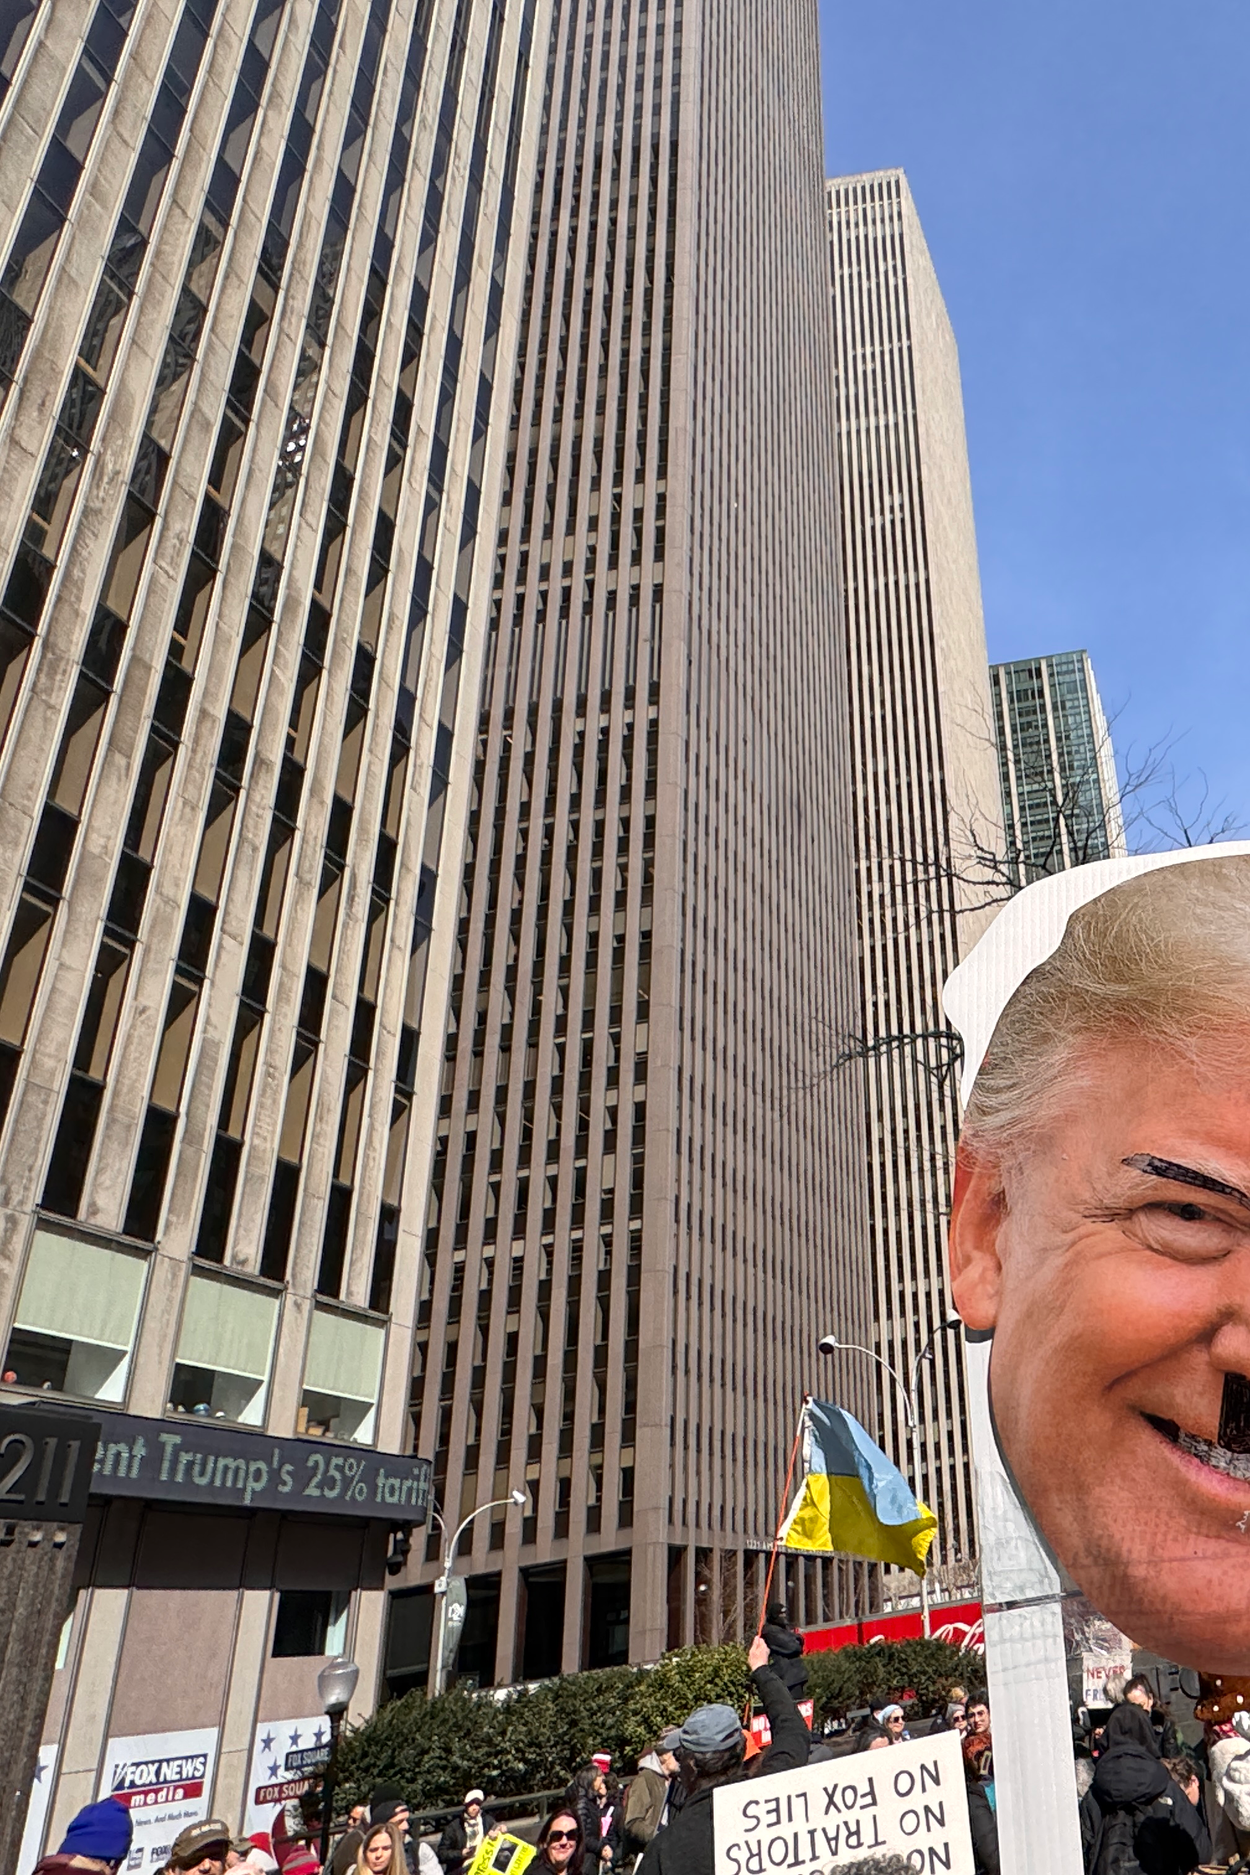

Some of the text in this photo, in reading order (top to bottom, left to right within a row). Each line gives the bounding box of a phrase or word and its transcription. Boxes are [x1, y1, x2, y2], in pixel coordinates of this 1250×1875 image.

[158, 1432, 295, 1505] Trump's
[302, 1453, 368, 1502] 25%
[124, 1757, 206, 1787] FOX NEWS
[130, 1785, 185, 1807] media
[259, 1779, 314, 1801] FOX SQUA
[742, 1760, 942, 1833] NO FOX LIES
[725, 1801, 946, 1875] NO TRAITORS
